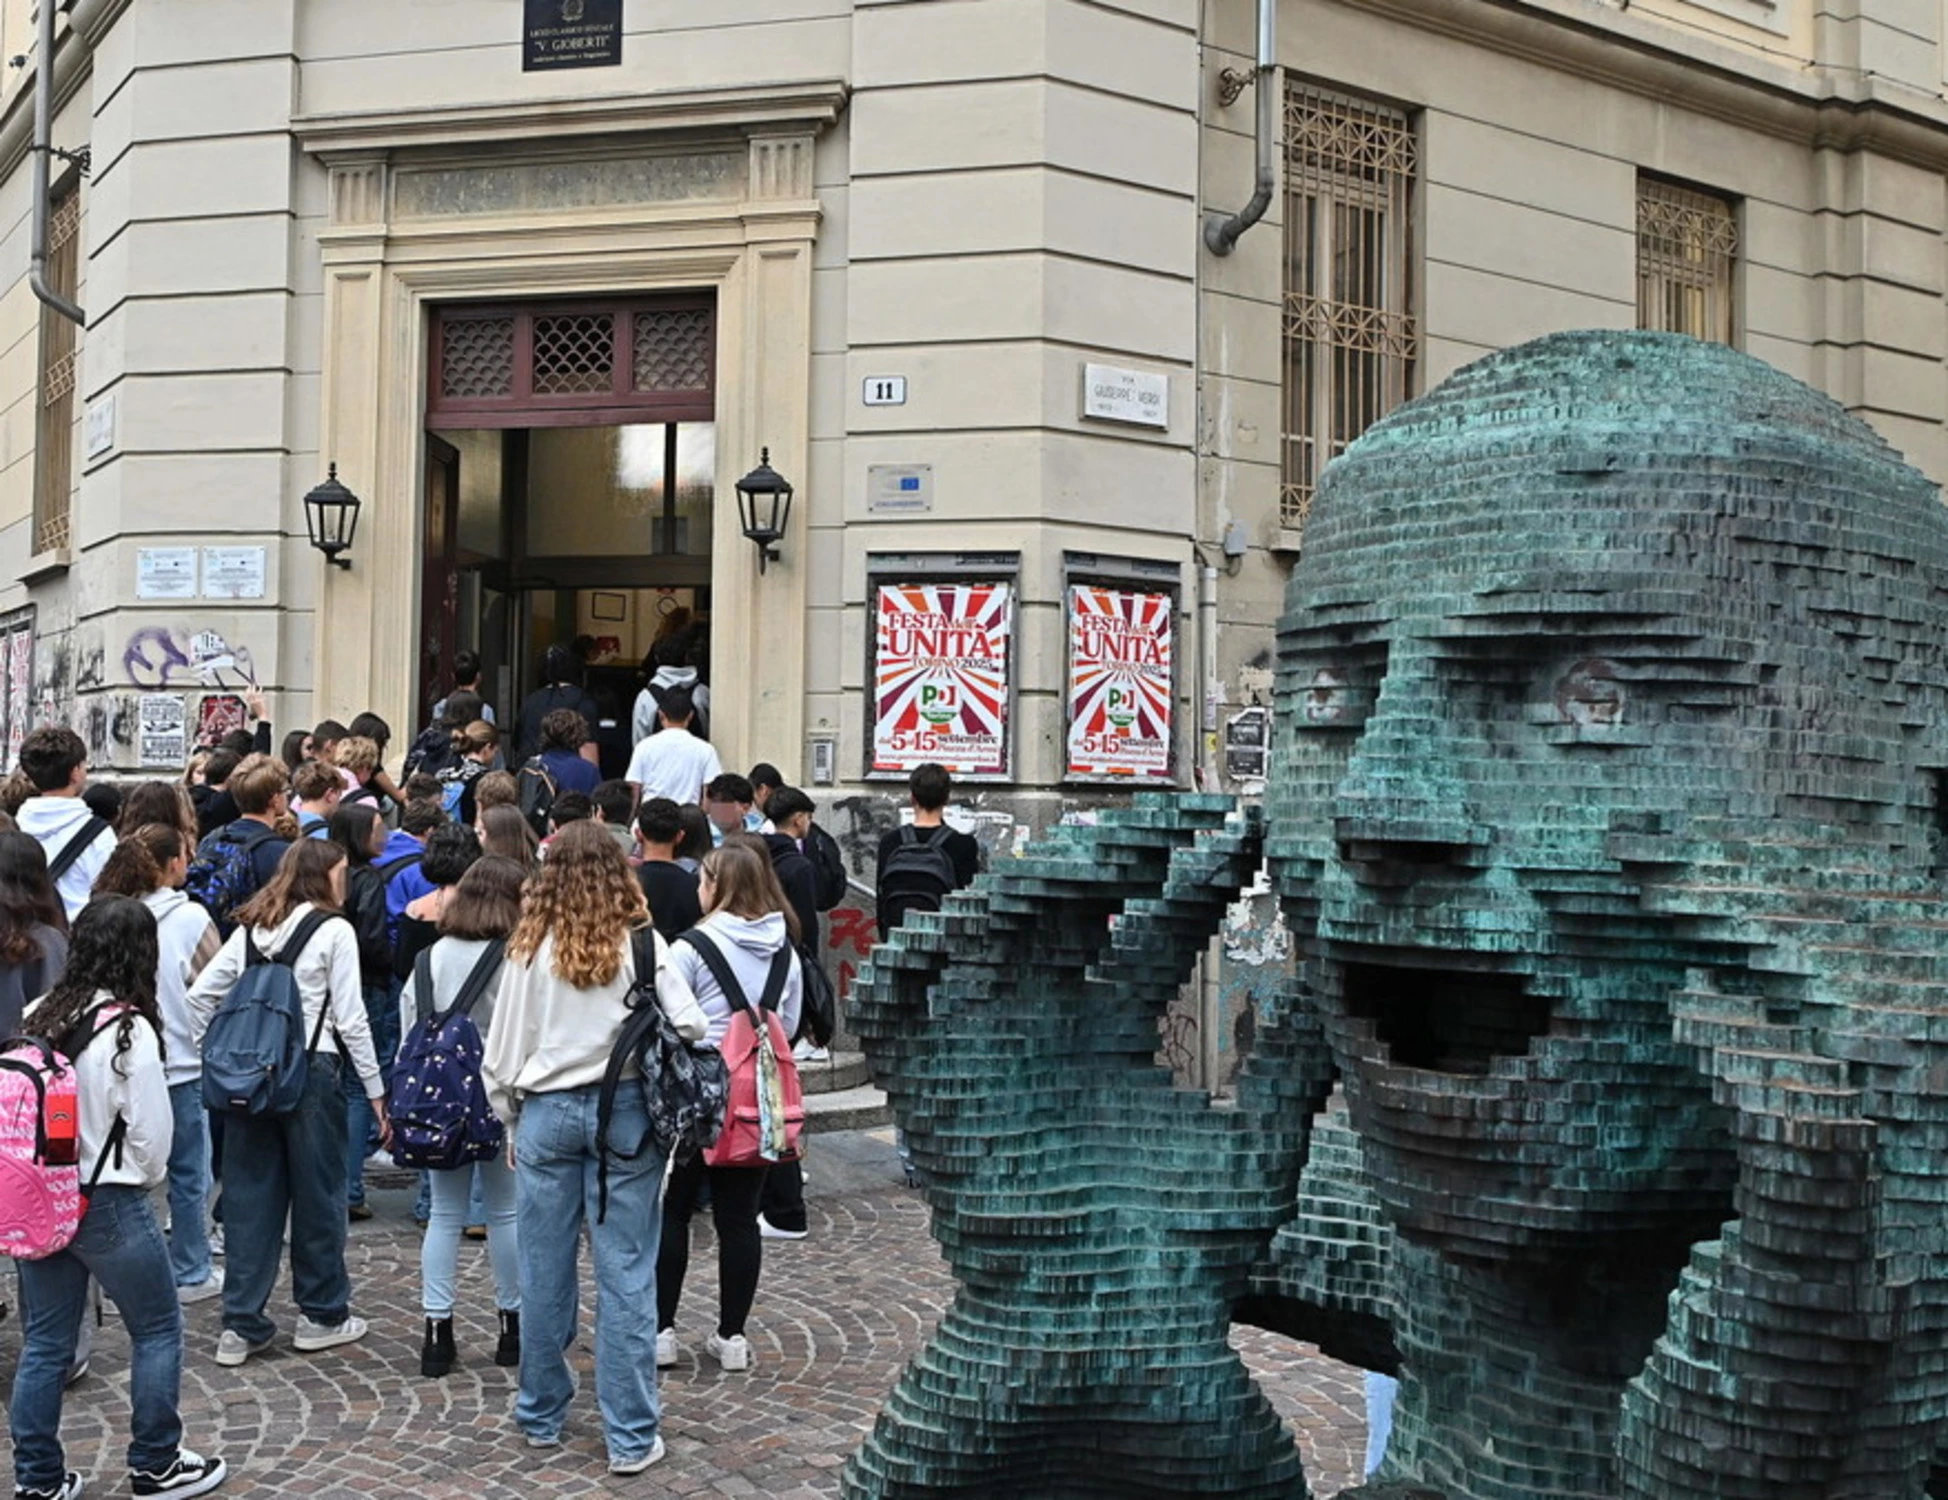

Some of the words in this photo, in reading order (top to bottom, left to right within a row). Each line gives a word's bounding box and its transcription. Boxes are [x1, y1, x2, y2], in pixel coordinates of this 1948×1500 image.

[875, 382, 893, 400] 11
[889, 612, 949, 629] FESTA
[1081, 614, 1130, 634] FESTA
[889, 624, 993, 657] UNITÀ
[1082, 631, 1162, 665] UNITÀ
[938, 732, 998, 744] settembre
